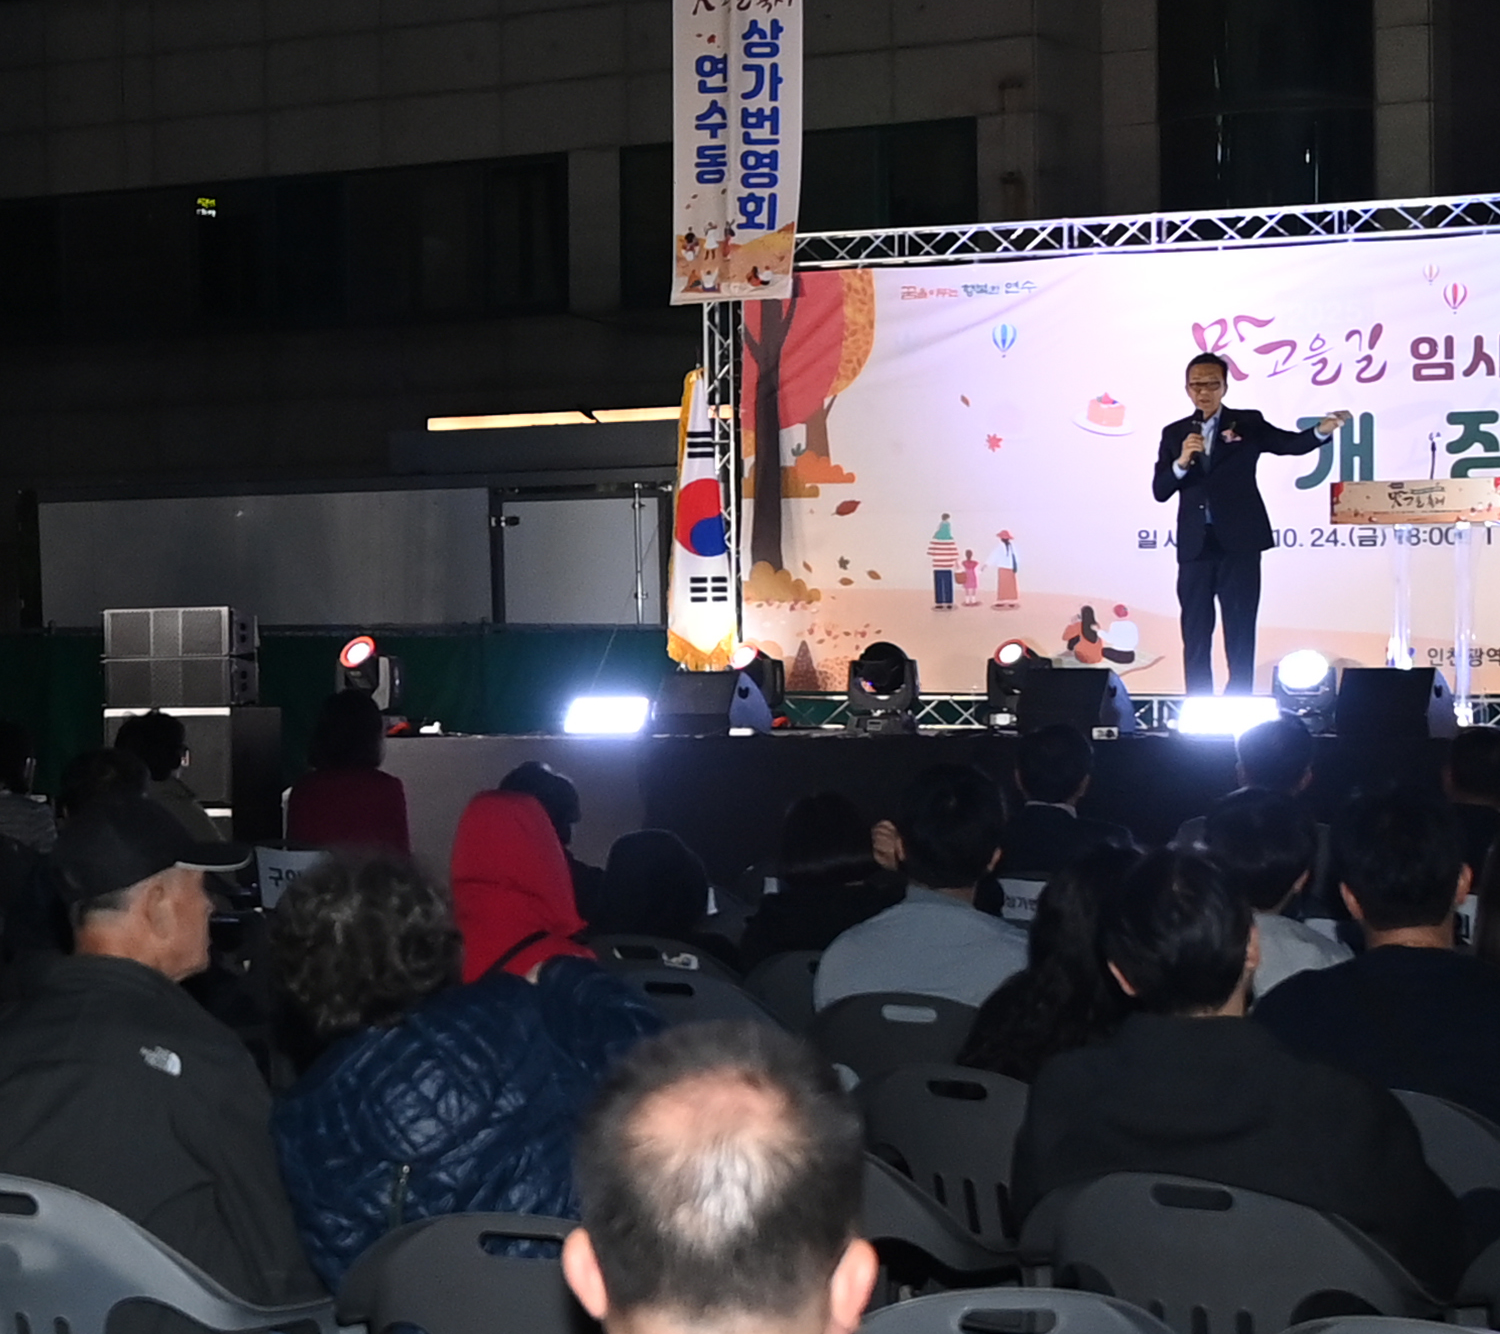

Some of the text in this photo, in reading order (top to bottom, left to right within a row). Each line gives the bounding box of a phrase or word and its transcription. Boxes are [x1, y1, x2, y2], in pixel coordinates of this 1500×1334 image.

[694, 53, 729, 186] 연수동
[736, 17, 785, 232] 상가번영회
[1005, 280, 1038, 295] 연수
